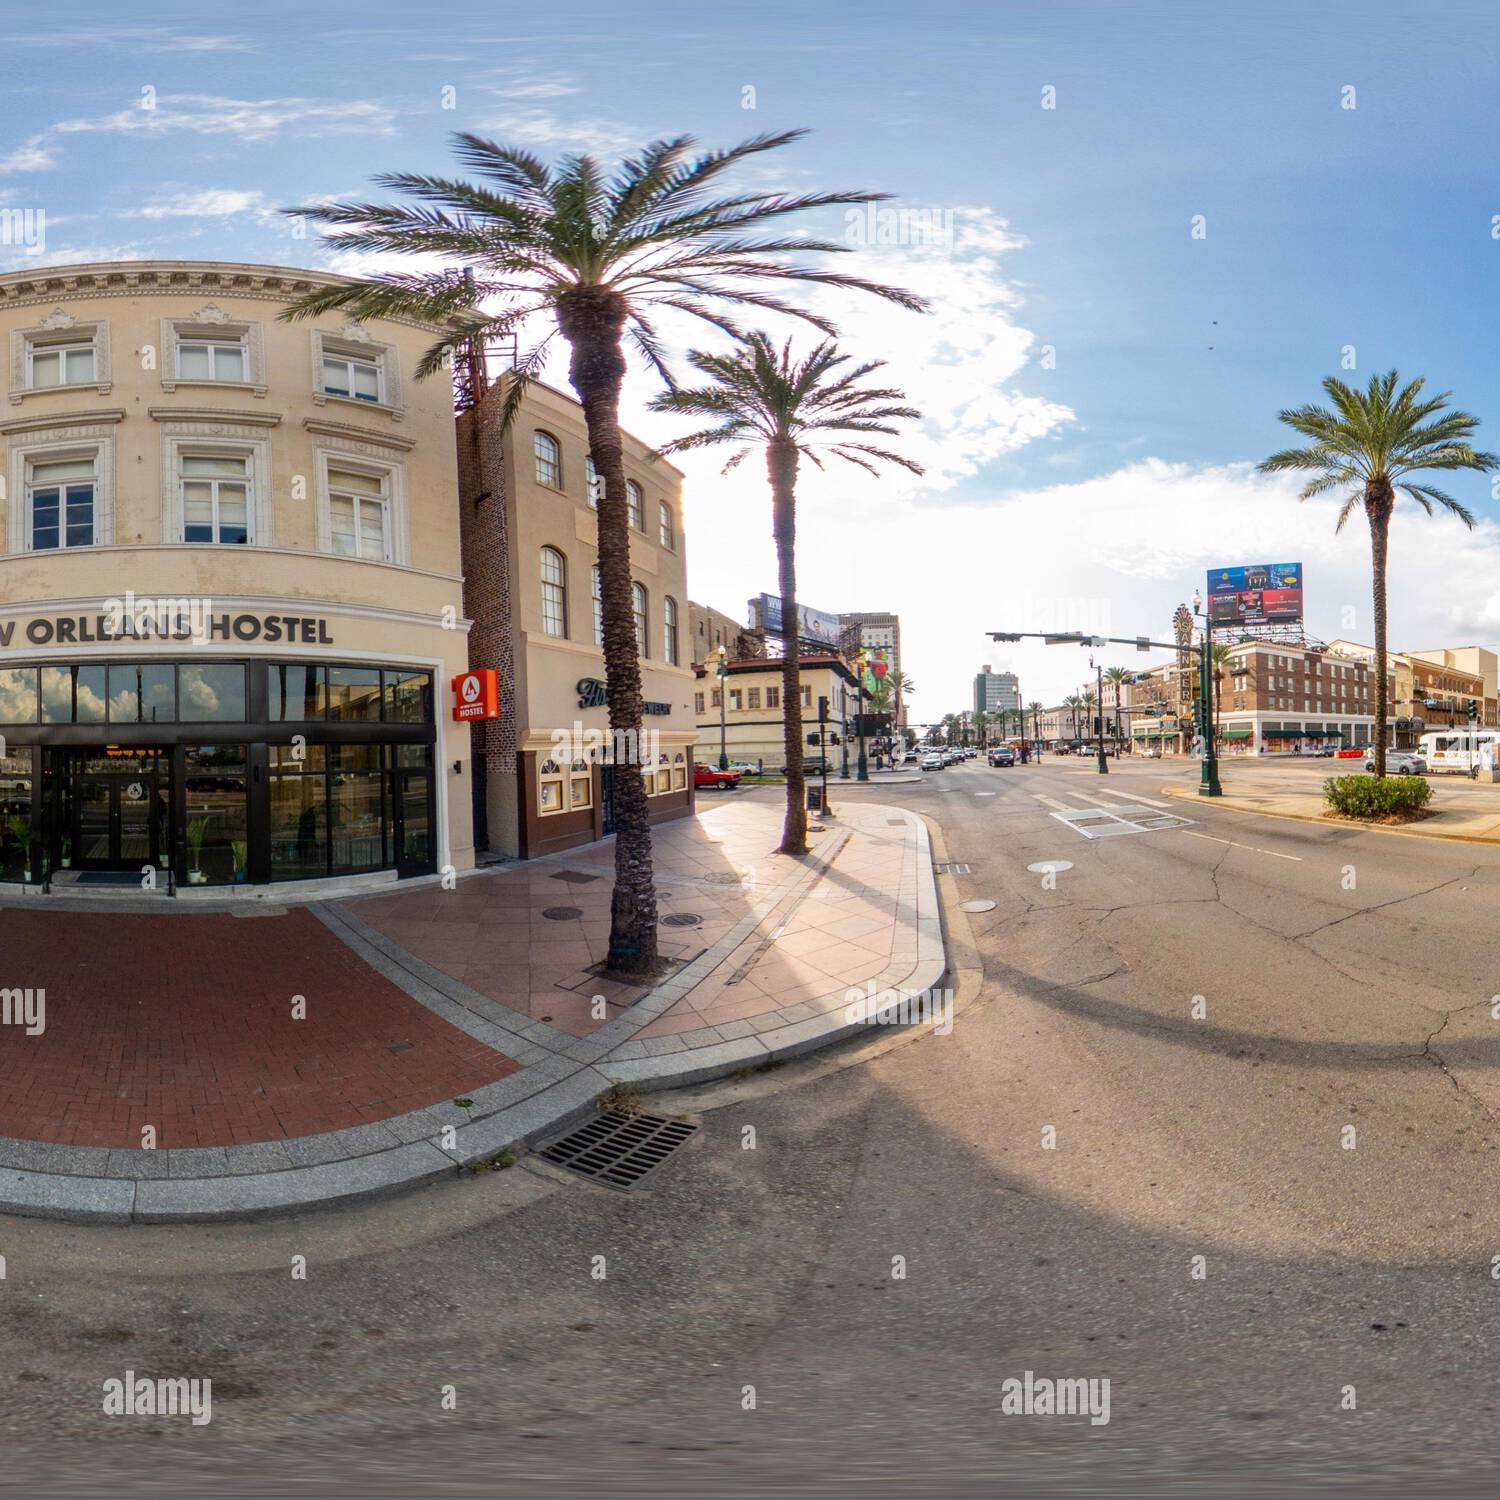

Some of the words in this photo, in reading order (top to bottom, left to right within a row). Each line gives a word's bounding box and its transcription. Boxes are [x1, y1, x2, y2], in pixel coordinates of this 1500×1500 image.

[26, 614, 192, 644] ORLEANS
[209, 614, 334, 644] HOSTEL
[1181, 621, 1190, 700] SANER
[460, 707, 484, 717] HOSTEL
[641, 701, 672, 715] EWELRY
